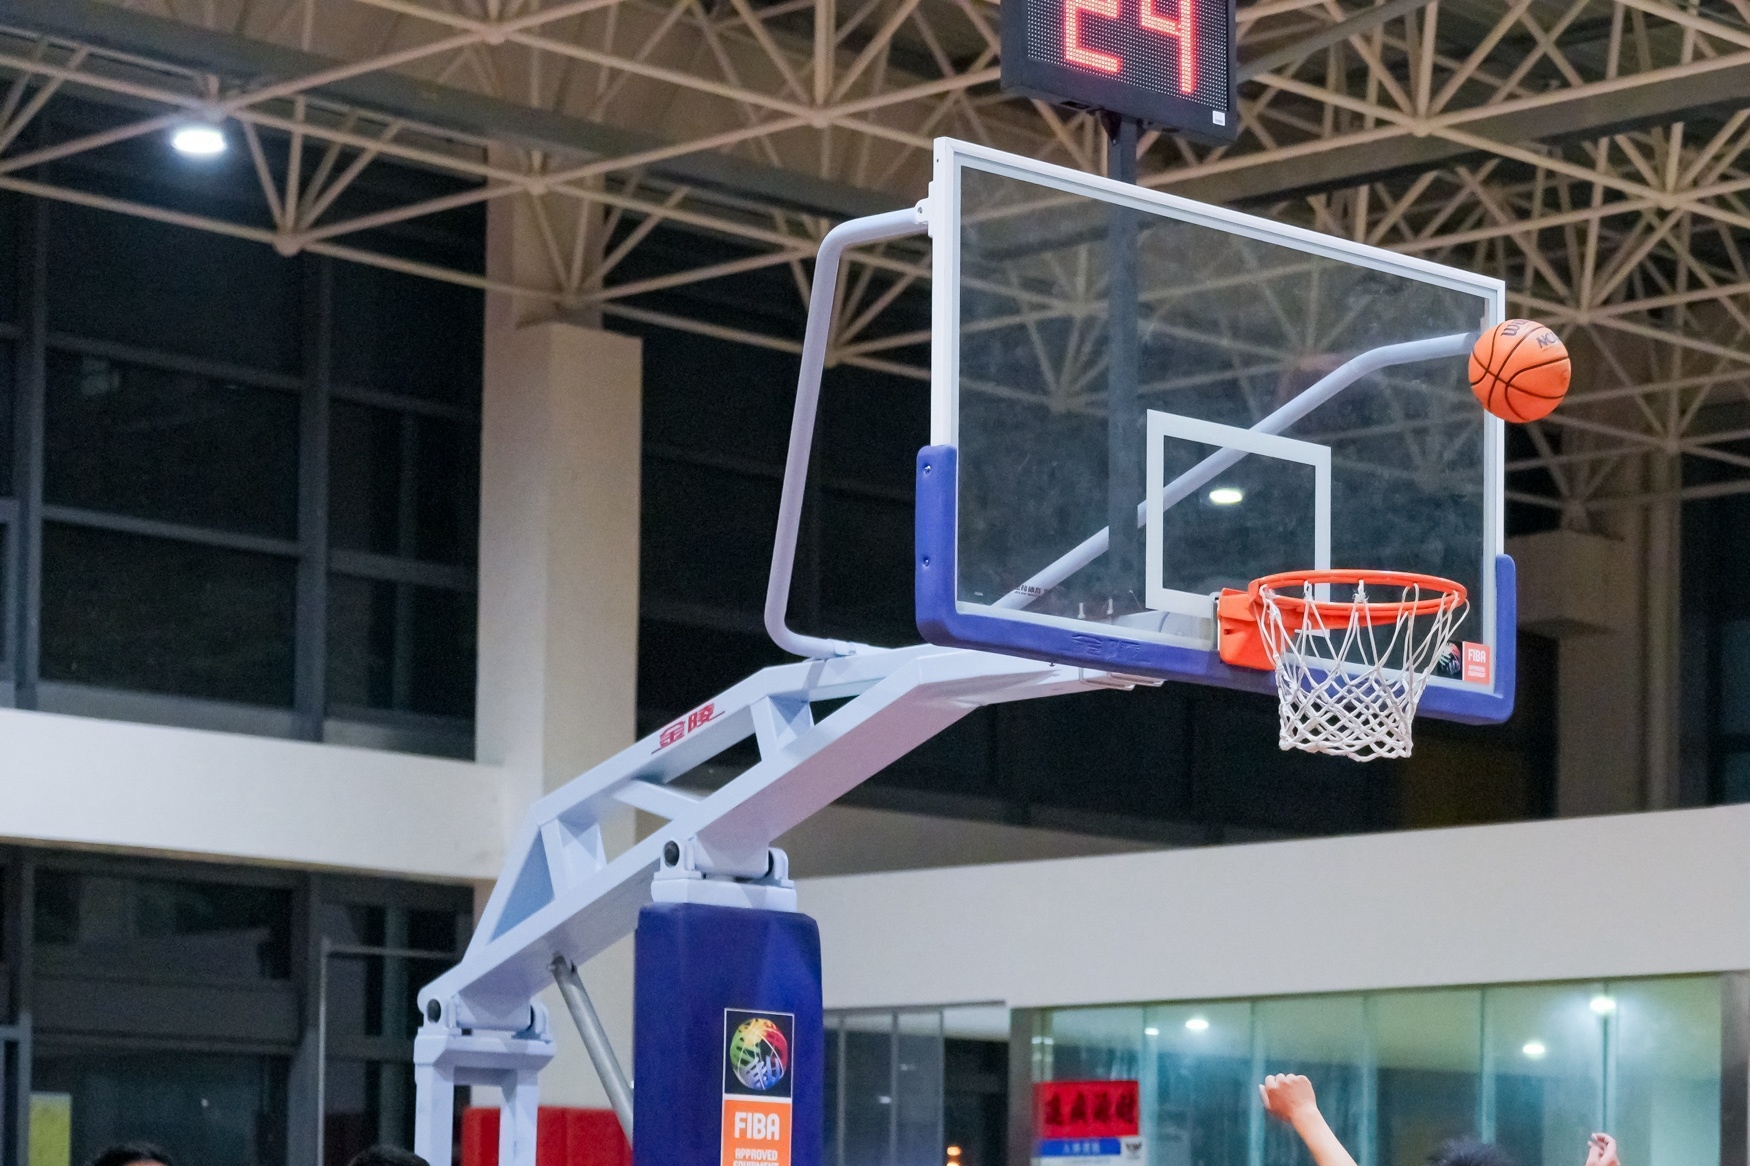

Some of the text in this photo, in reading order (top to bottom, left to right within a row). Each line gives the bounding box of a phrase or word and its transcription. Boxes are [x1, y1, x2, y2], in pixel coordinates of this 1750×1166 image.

[1063, 0, 1198, 95] 24
[1467, 648, 1487, 664] FIBA
[659, 702, 715, 749] 金陵
[734, 1111, 780, 1141] FIBA
[735, 1147, 778, 1161] APPROVED
